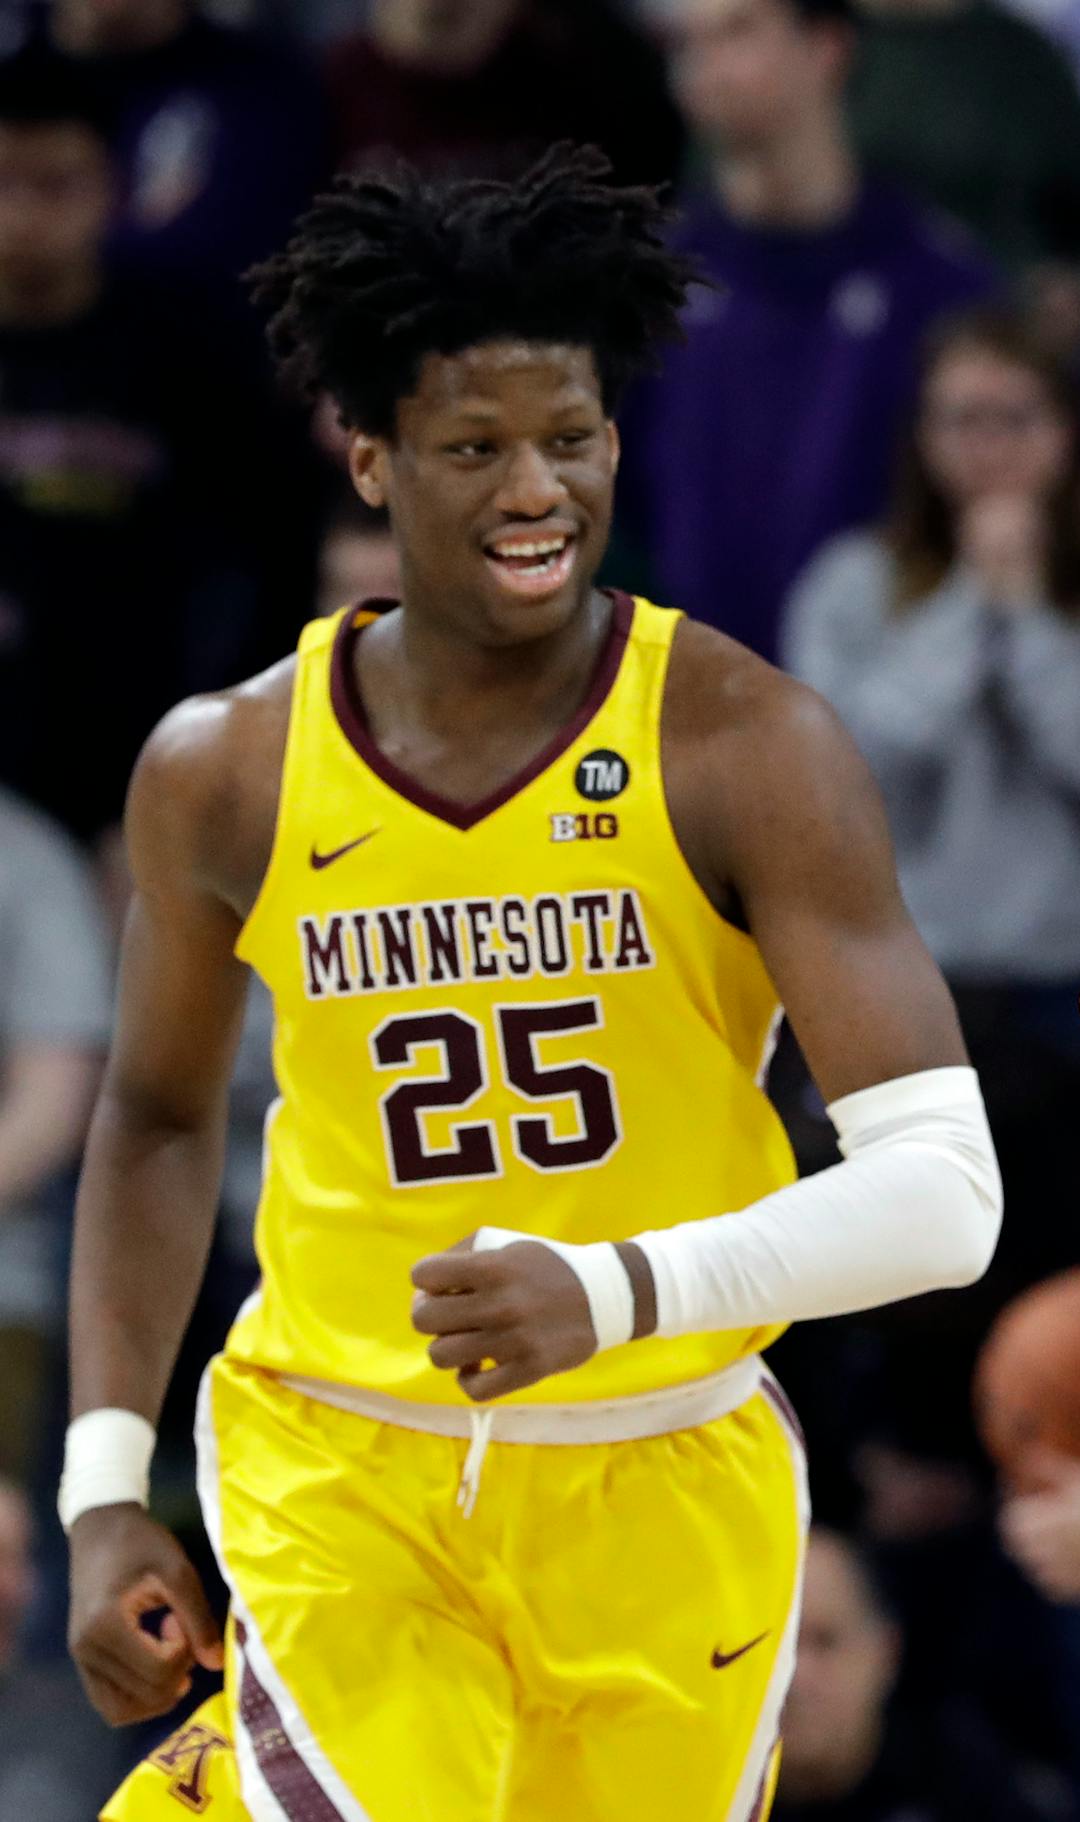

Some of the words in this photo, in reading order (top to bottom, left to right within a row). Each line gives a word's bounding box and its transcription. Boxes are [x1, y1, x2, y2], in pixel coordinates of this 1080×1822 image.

[581, 760, 622, 792] TM
[301, 887, 655, 1000] MINNESOTA
[368, 995, 623, 1188] 25
